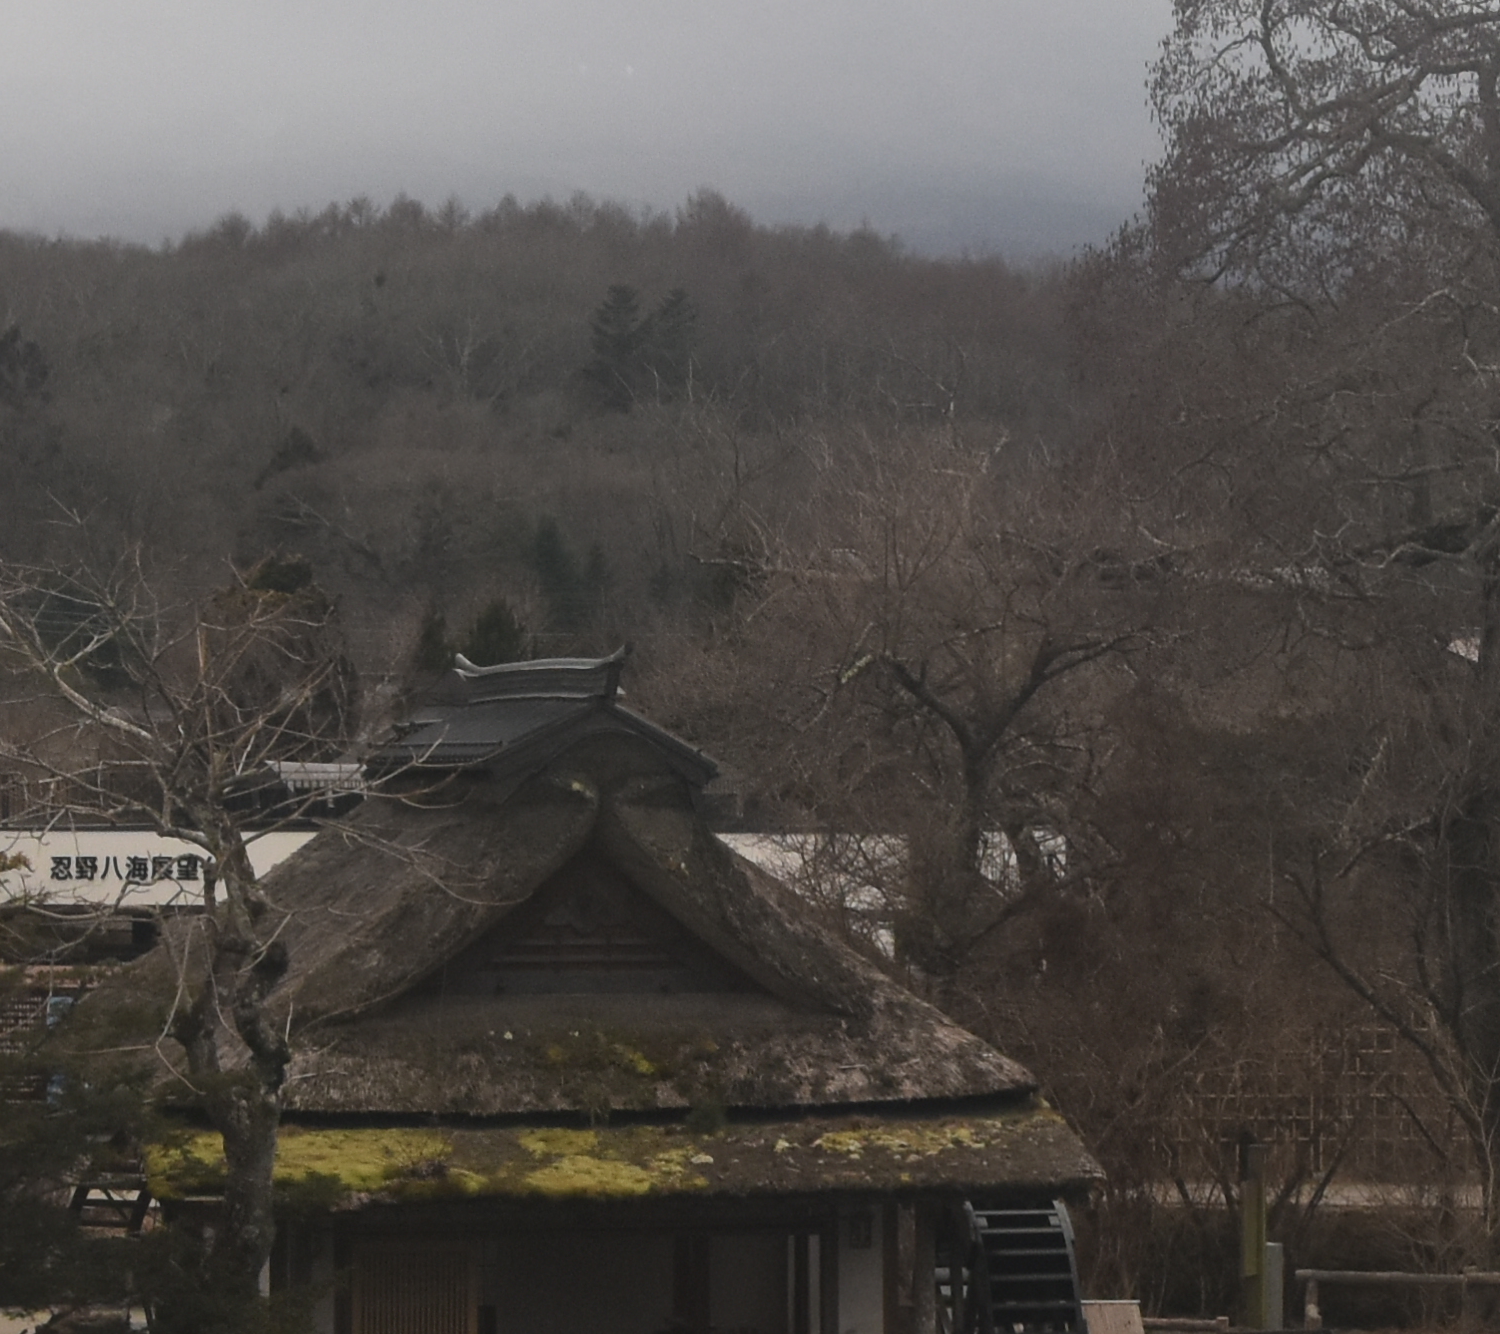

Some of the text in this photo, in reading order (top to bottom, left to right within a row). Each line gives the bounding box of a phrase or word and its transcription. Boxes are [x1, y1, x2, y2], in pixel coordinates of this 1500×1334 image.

[50, 855, 216, 882] 忍野八海展望
